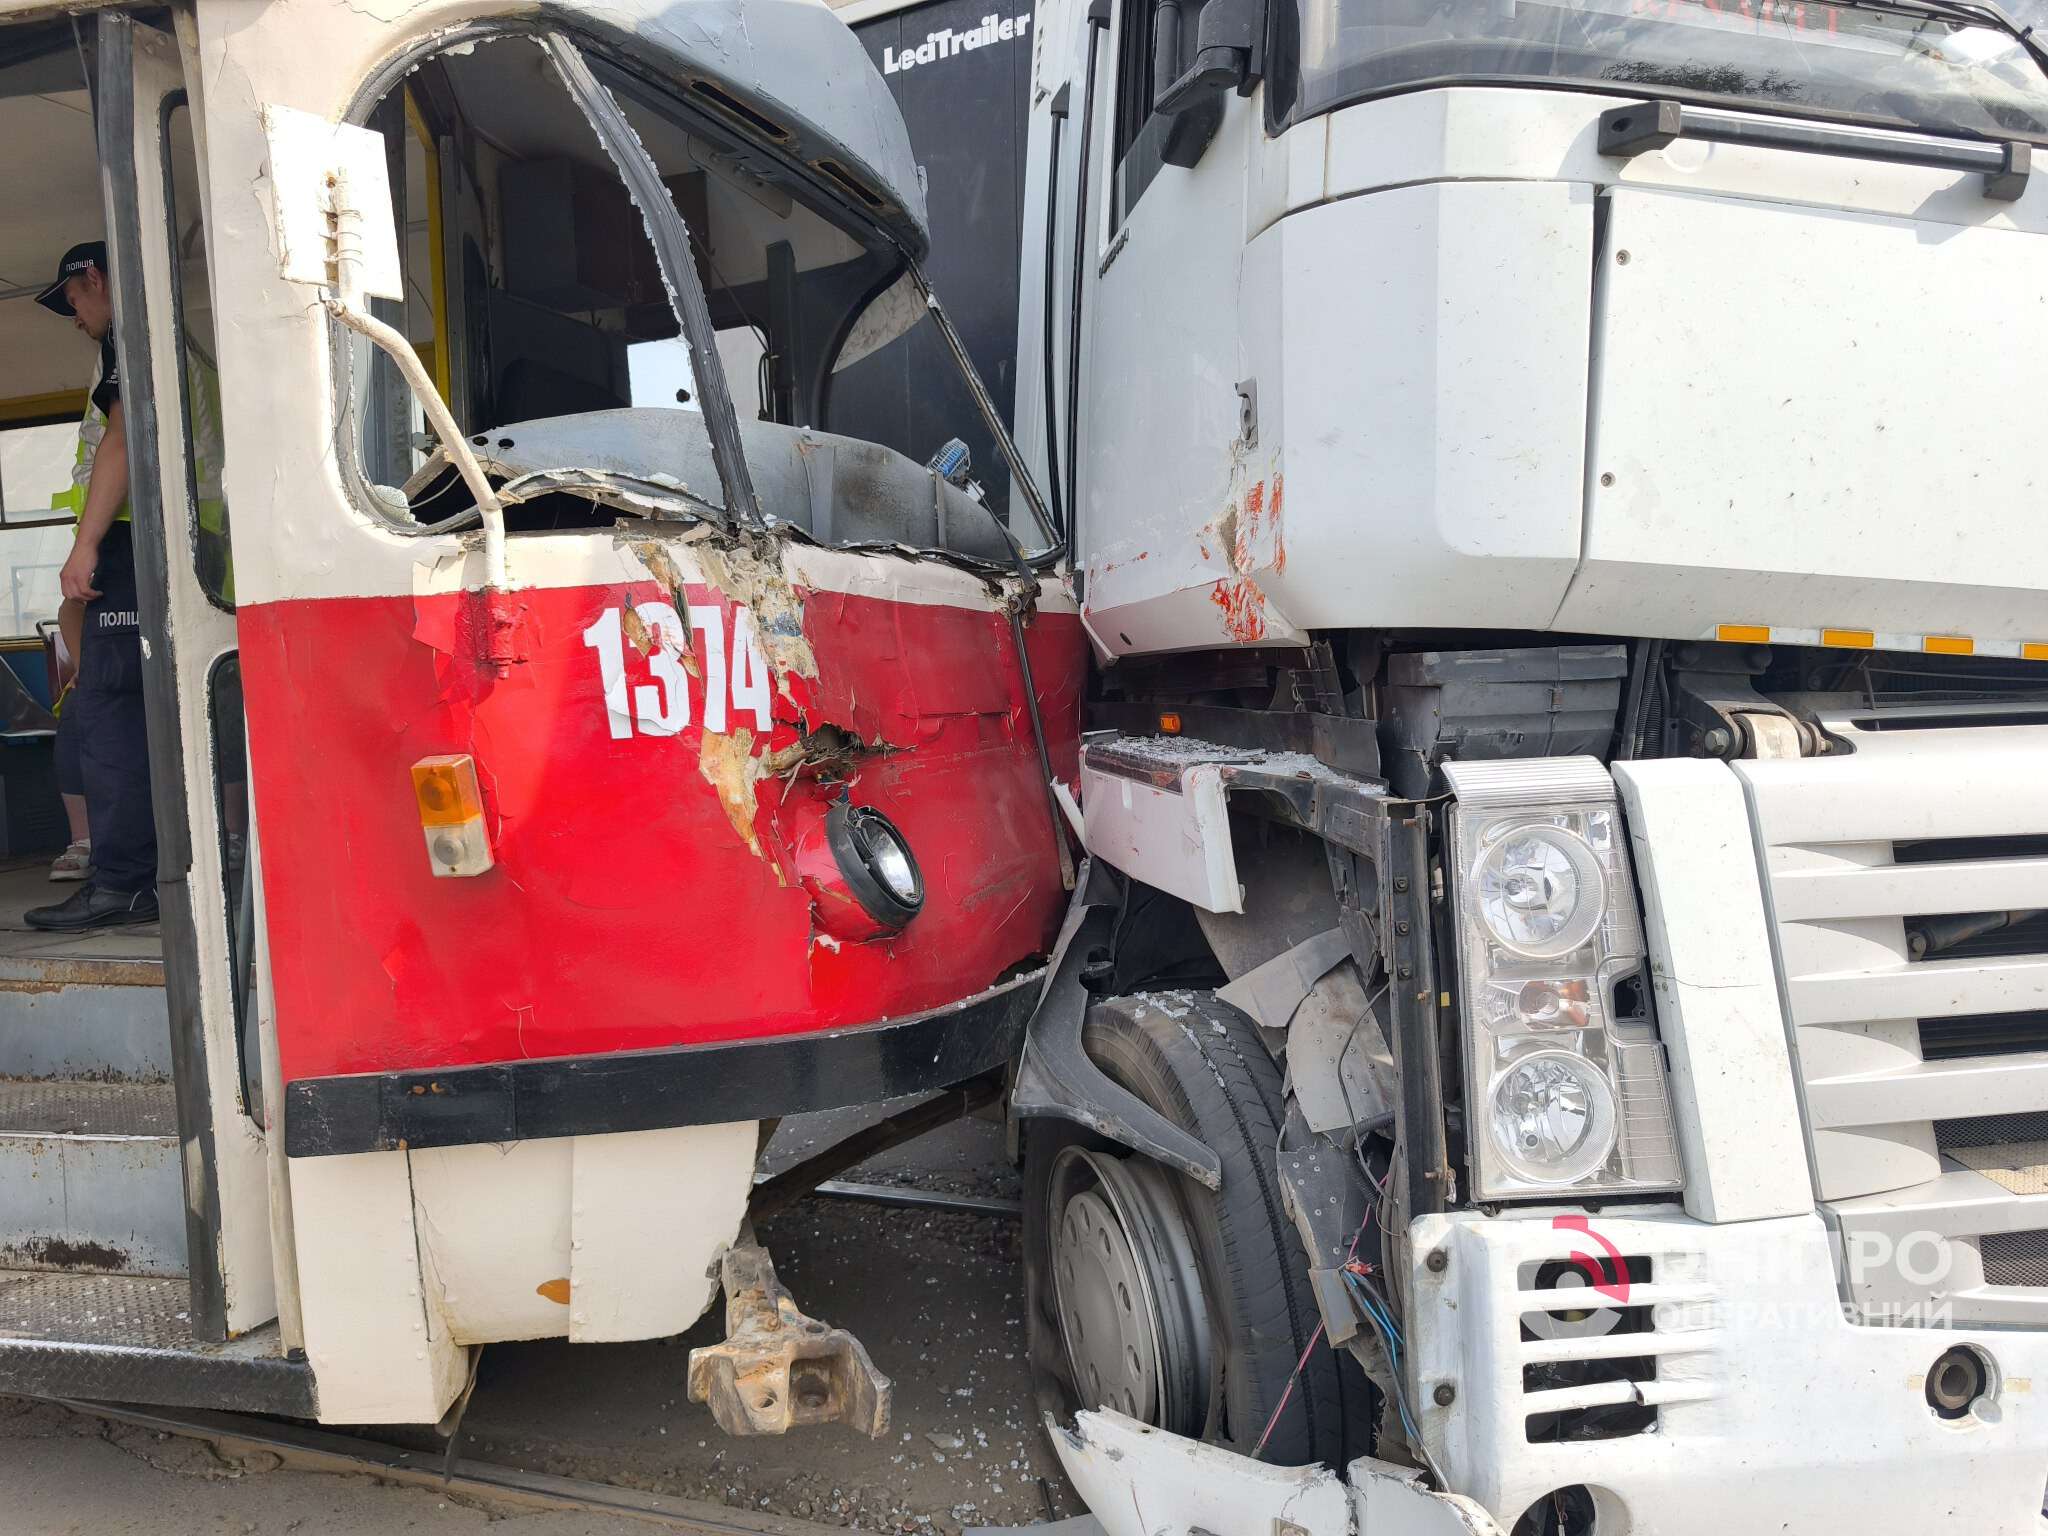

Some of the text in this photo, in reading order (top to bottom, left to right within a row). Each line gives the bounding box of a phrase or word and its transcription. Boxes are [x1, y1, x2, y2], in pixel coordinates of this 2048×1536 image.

[883, 13, 1031, 75] LeciTrailer
[66, 259, 94, 272] ПОЛІЦІЯ
[583, 601, 774, 740] 1374
